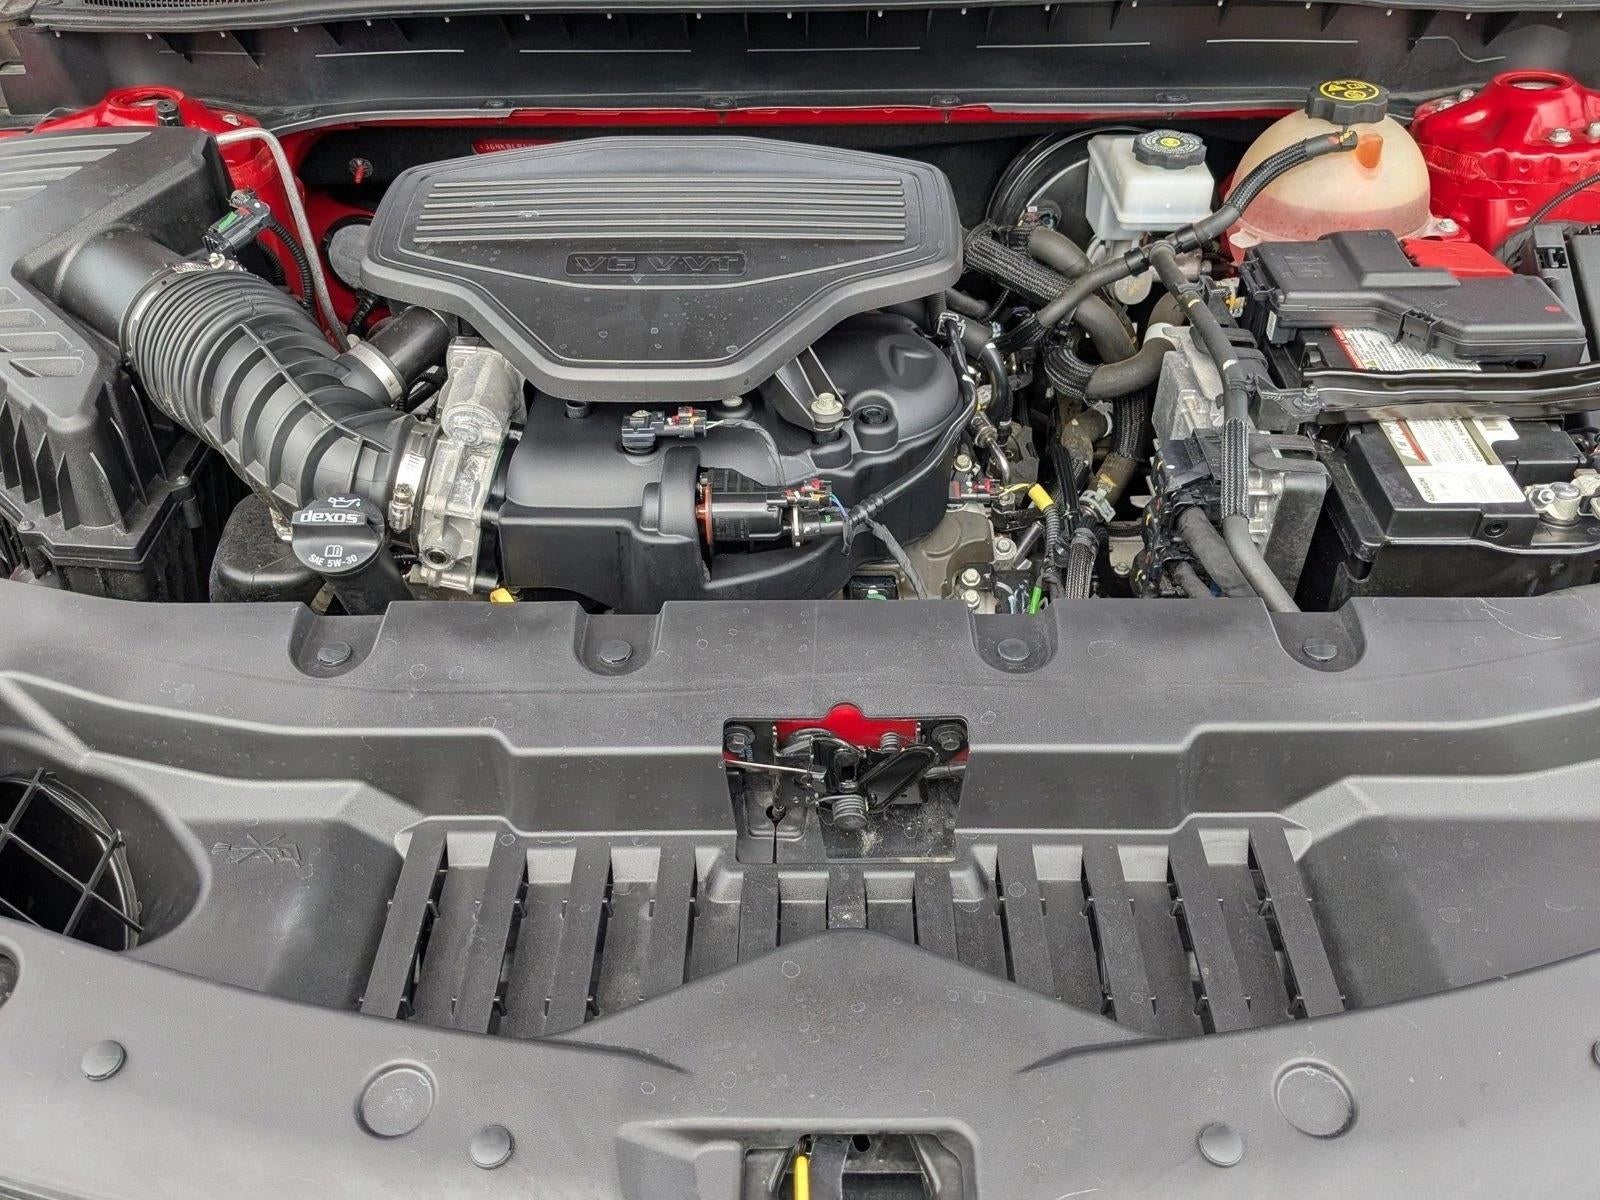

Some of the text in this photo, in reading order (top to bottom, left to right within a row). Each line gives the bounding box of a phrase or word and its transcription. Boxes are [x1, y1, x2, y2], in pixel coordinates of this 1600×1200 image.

[575, 256, 739, 272] V6 VVT
[300, 510, 359, 523] dexos
[308, 553, 358, 568] SAE 5W-30
